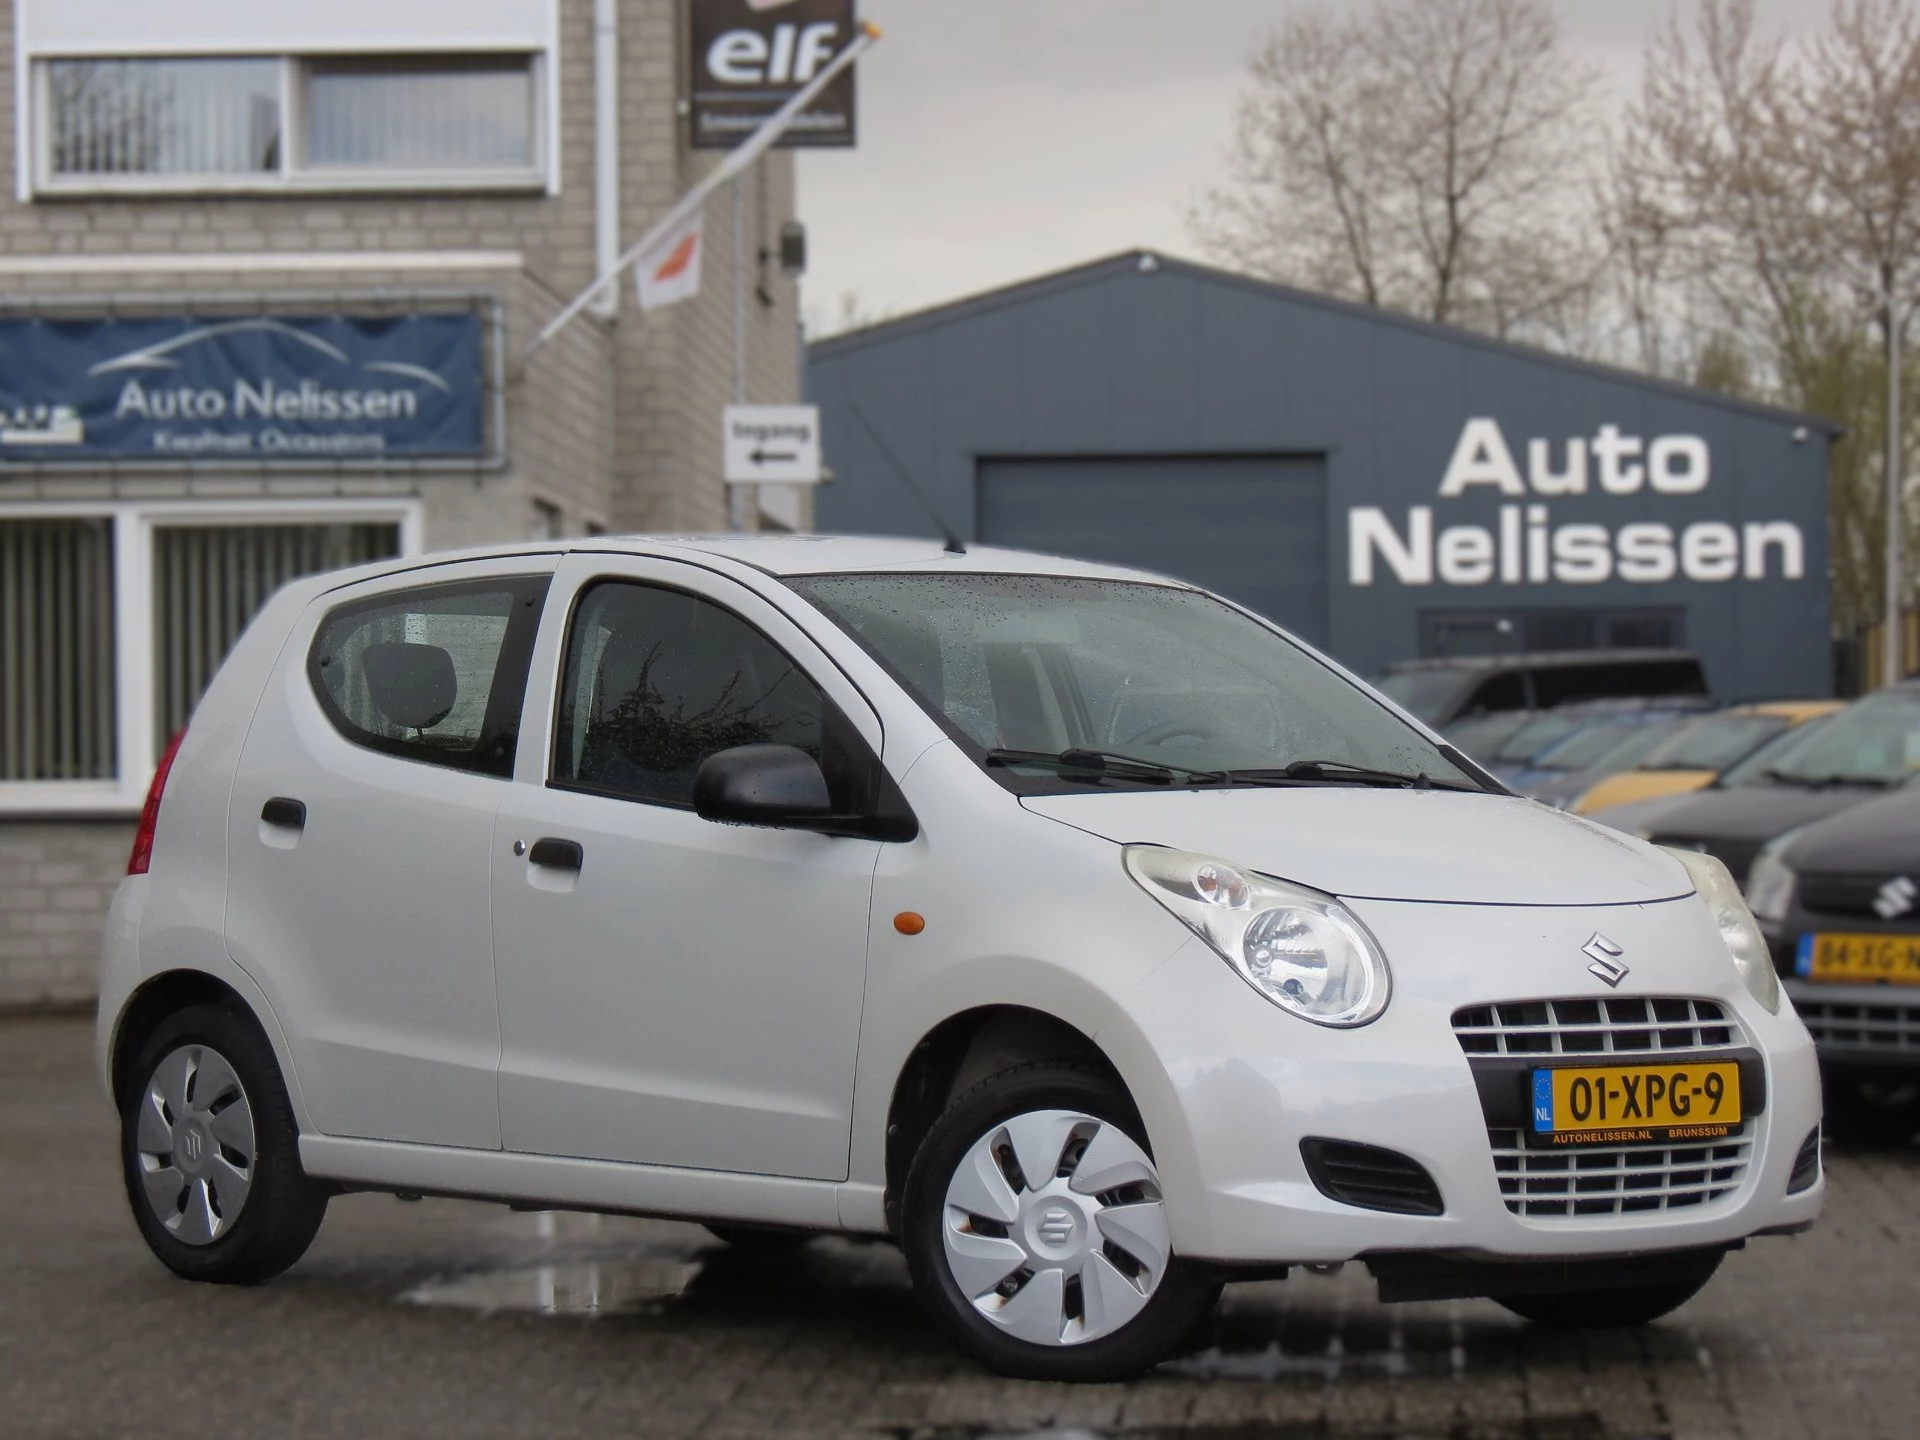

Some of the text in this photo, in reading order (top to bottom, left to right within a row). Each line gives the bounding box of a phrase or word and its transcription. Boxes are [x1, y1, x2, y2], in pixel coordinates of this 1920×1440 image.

[706, 21, 838, 84] elf
[114, 377, 417, 420] Auto Nelissen
[1438, 417, 1711, 497] Auto
[1348, 505, 1804, 586] Nelissen
[1536, 1107, 1551, 1122] NL
[1569, 1071, 1725, 1122] 01-XPG-9
[1553, 1127, 1728, 1145] AUTONELISSEN.NL BRUNSSUM
